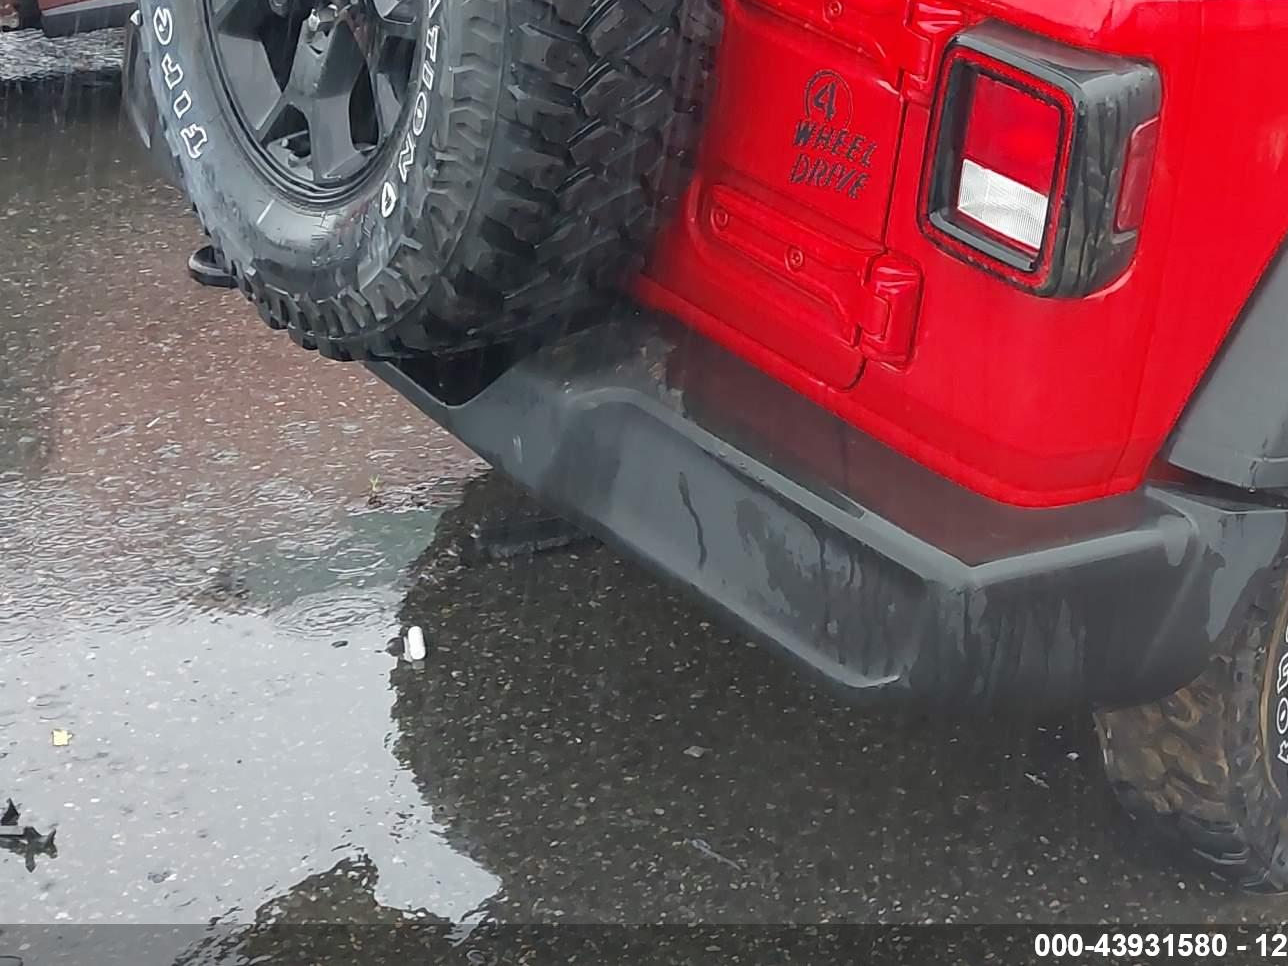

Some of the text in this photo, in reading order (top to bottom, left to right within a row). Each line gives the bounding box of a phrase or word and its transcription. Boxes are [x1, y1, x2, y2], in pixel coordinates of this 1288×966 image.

[812, 81, 837, 122] 4
[792, 119, 877, 169] WHEEL
[789, 153, 869, 199] DRIVE
